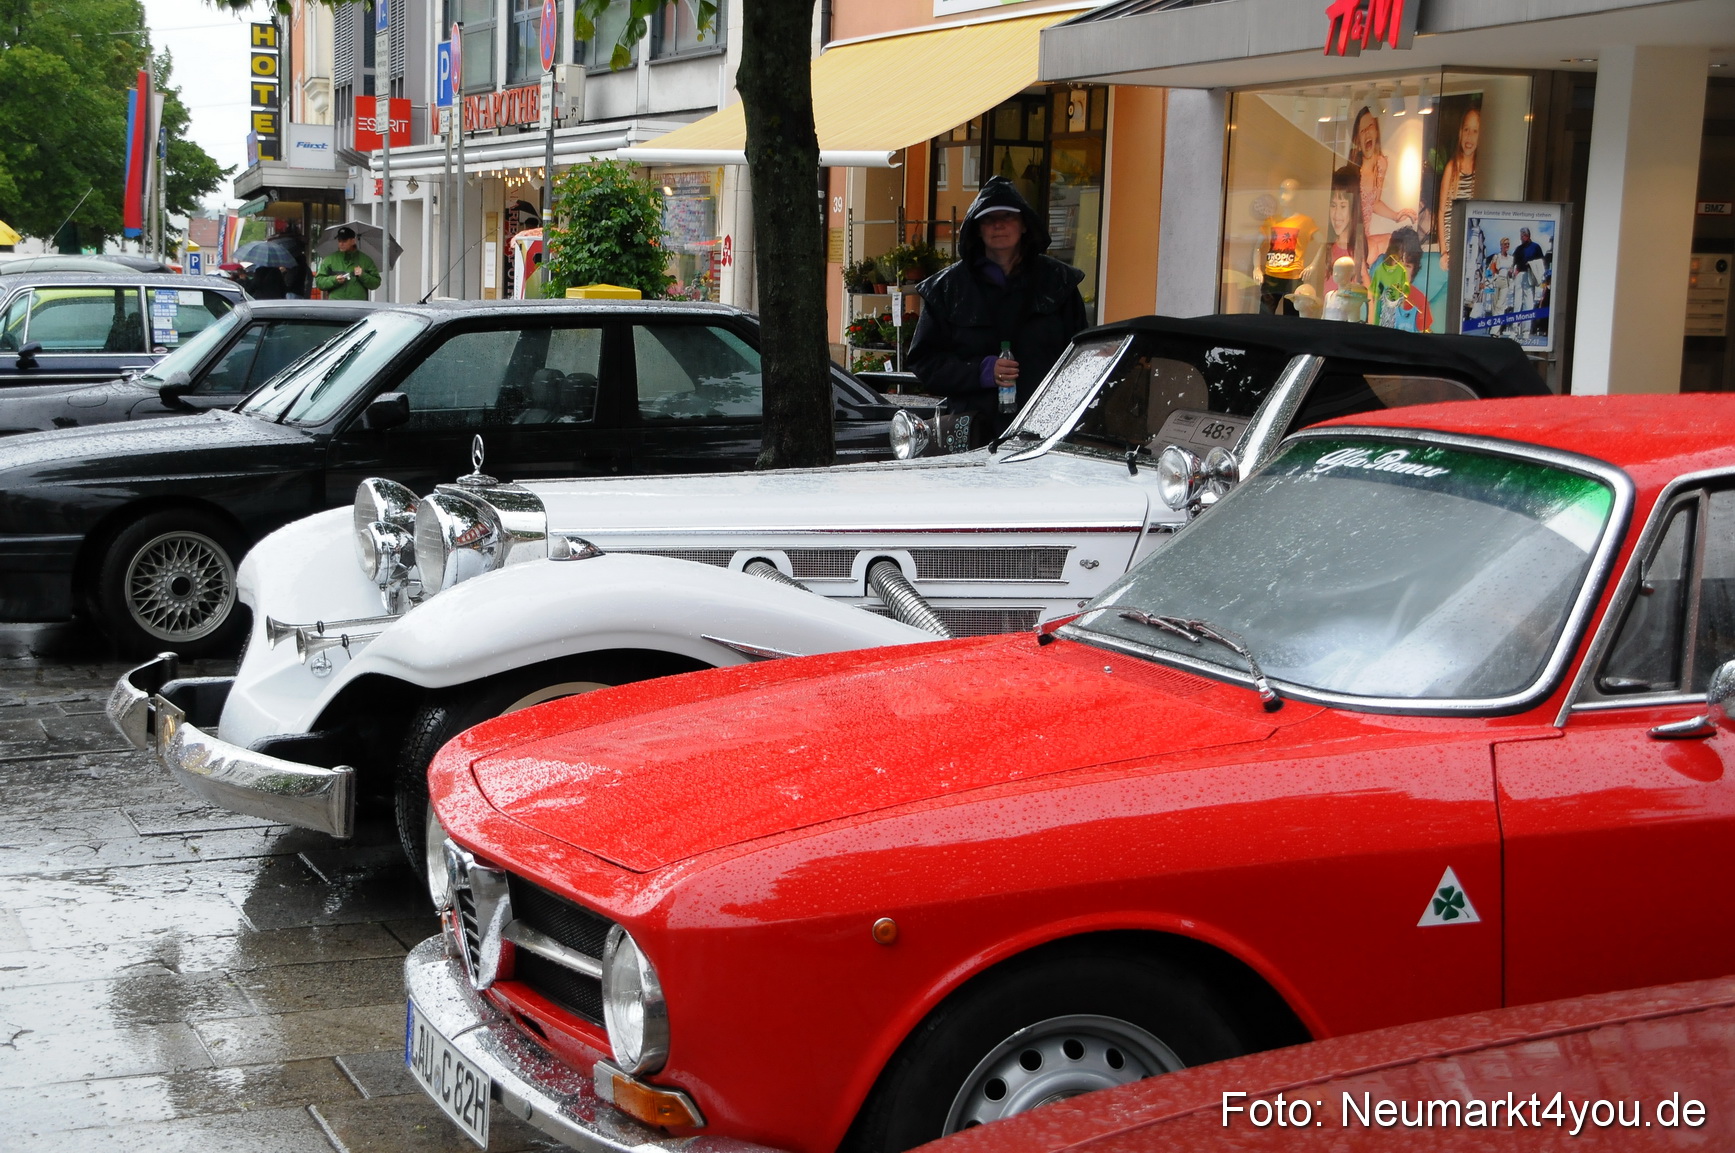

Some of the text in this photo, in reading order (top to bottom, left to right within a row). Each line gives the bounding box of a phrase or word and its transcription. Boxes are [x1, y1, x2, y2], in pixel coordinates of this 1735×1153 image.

[440, 51, 449, 99] P
[252, 26, 276, 161] HOTEL
[358, 117, 409, 133] ESRIT
[833, 197, 842, 212] 39
[1704, 204, 1725, 213] BMZ
[1512, 211, 1535, 219] Werbung
[191, 256, 199, 267] P
[1477, 320, 1486, 328] ab
[1515, 312, 1536, 321] Monat
[1201, 422, 1235, 441] 483
[1313, 447, 1451, 478] Alfa Romeo
[442, 1049, 452, 1103] C
[454, 1060, 487, 1137] 82H
